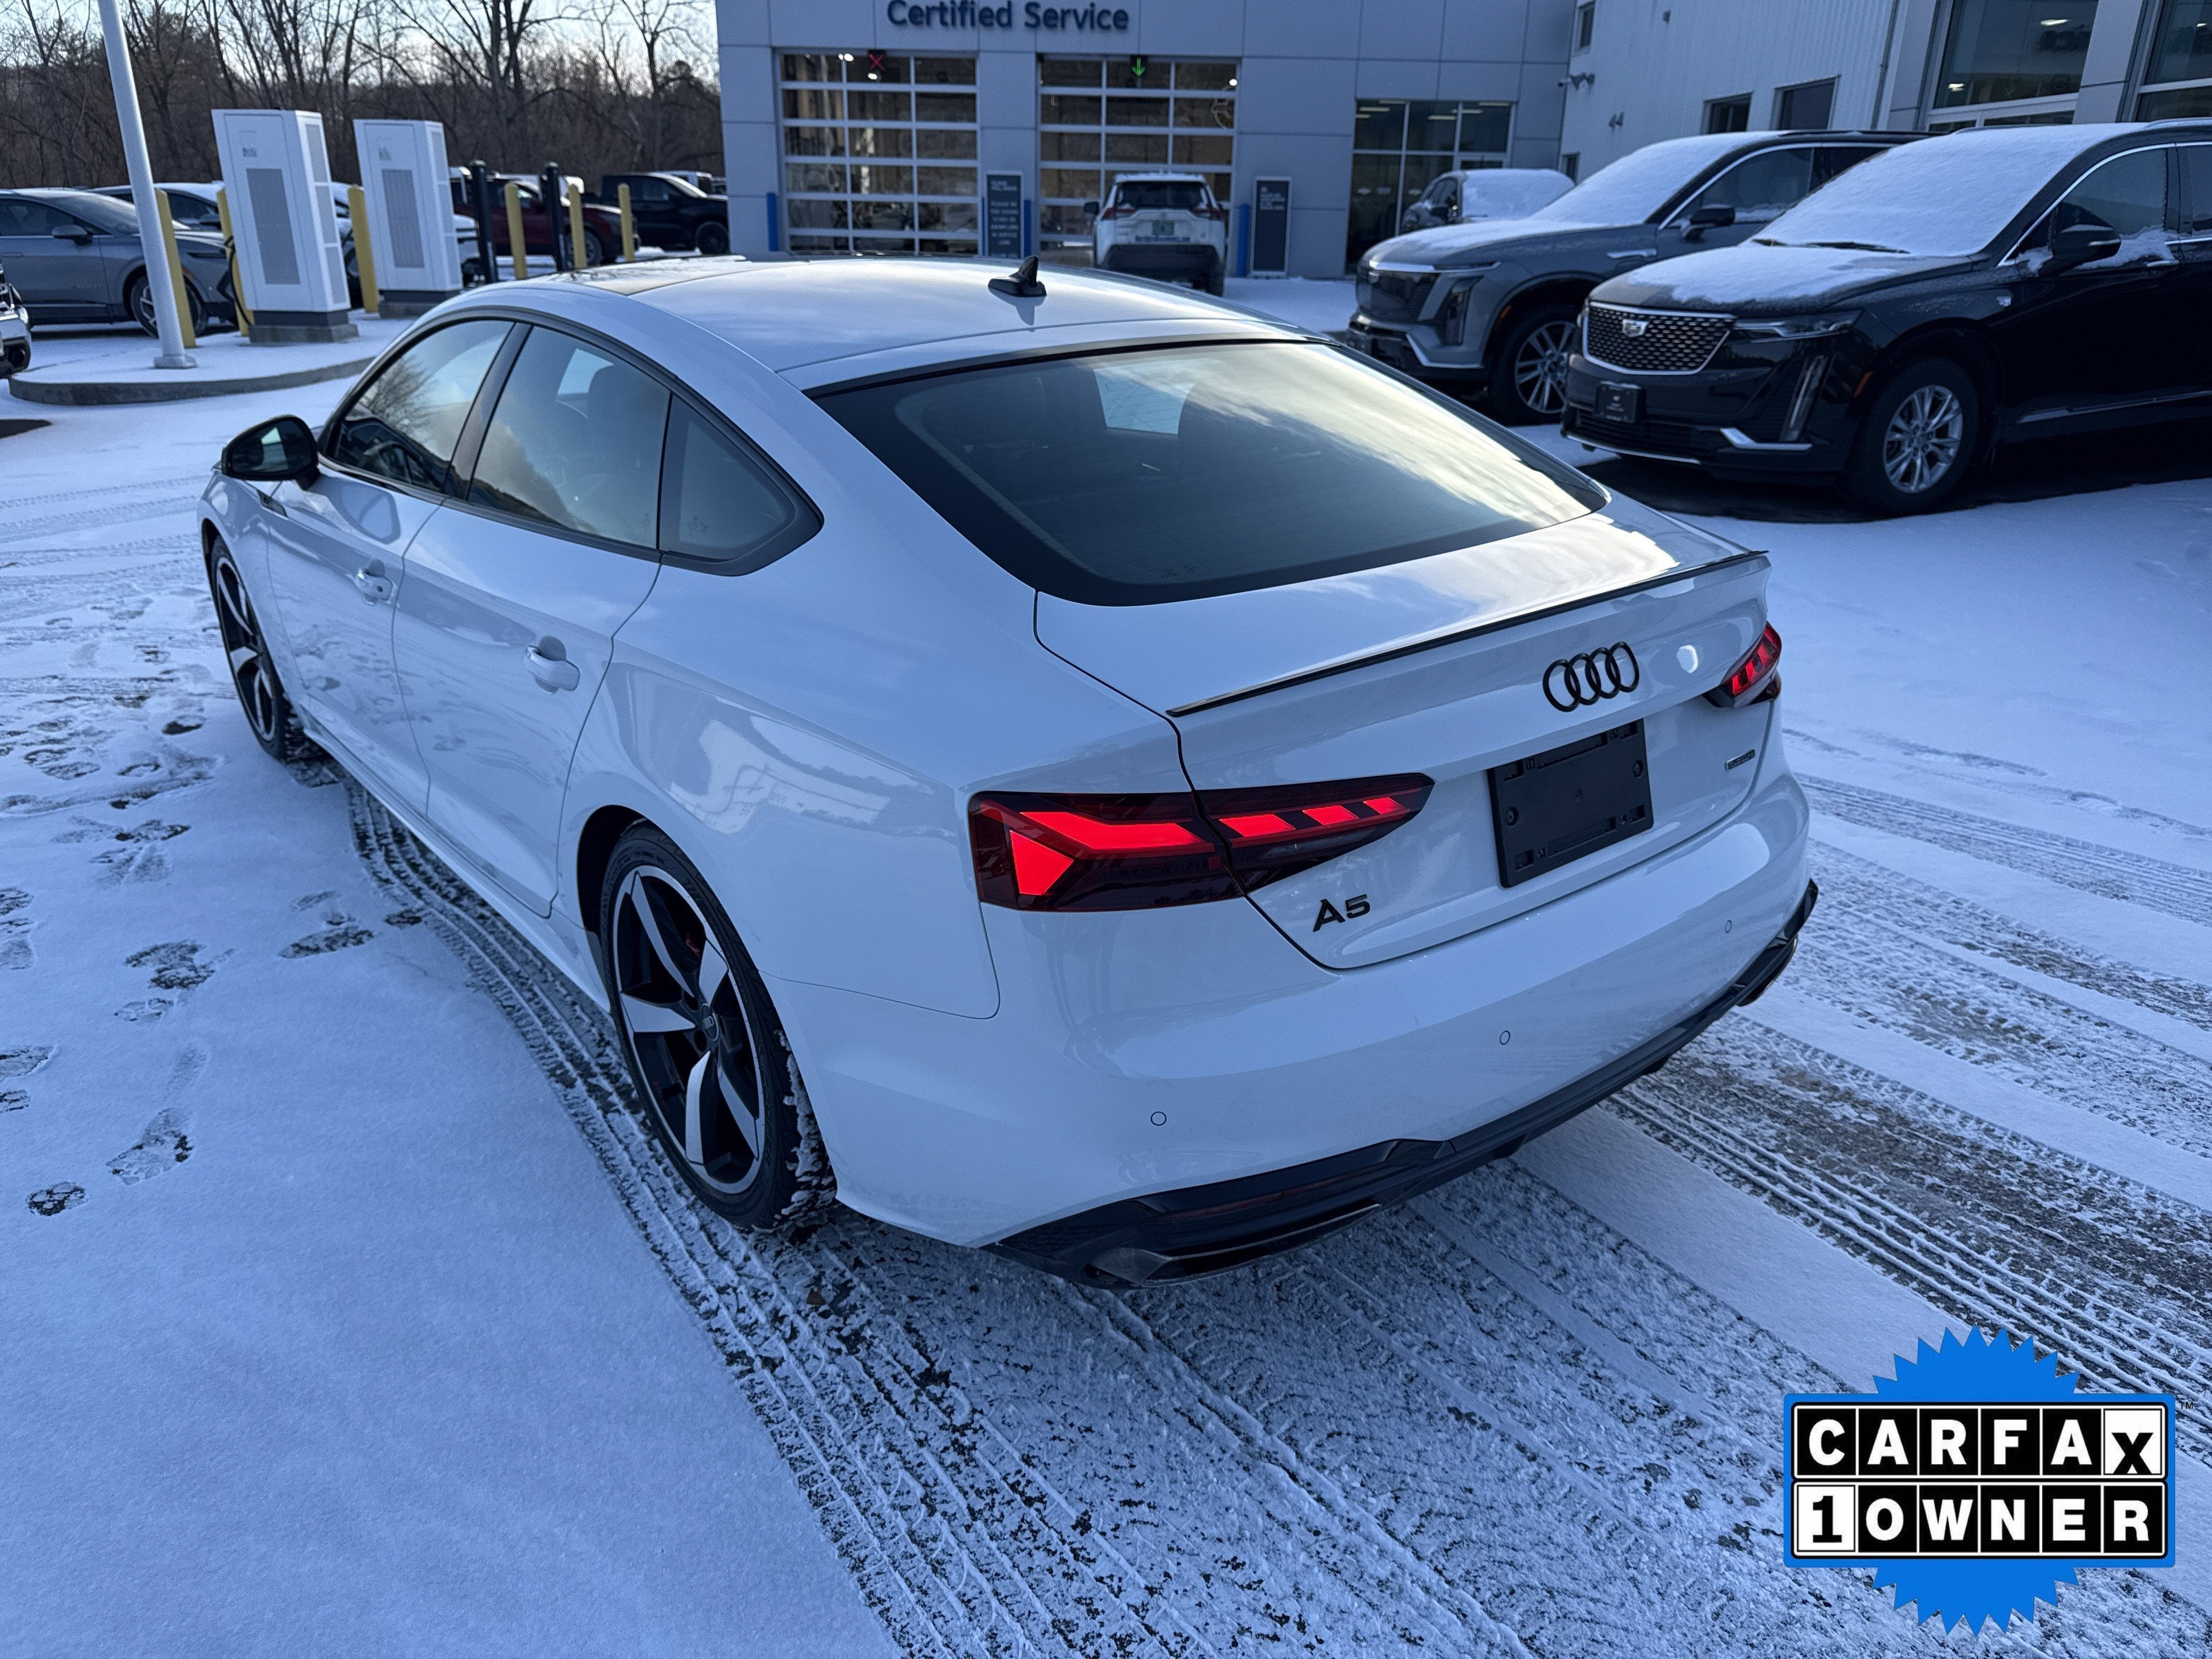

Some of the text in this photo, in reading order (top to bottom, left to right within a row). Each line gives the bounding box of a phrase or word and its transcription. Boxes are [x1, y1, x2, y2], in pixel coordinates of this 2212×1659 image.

[887, 0, 1128, 29] Certified Service
[1313, 894, 1370, 932] A5
